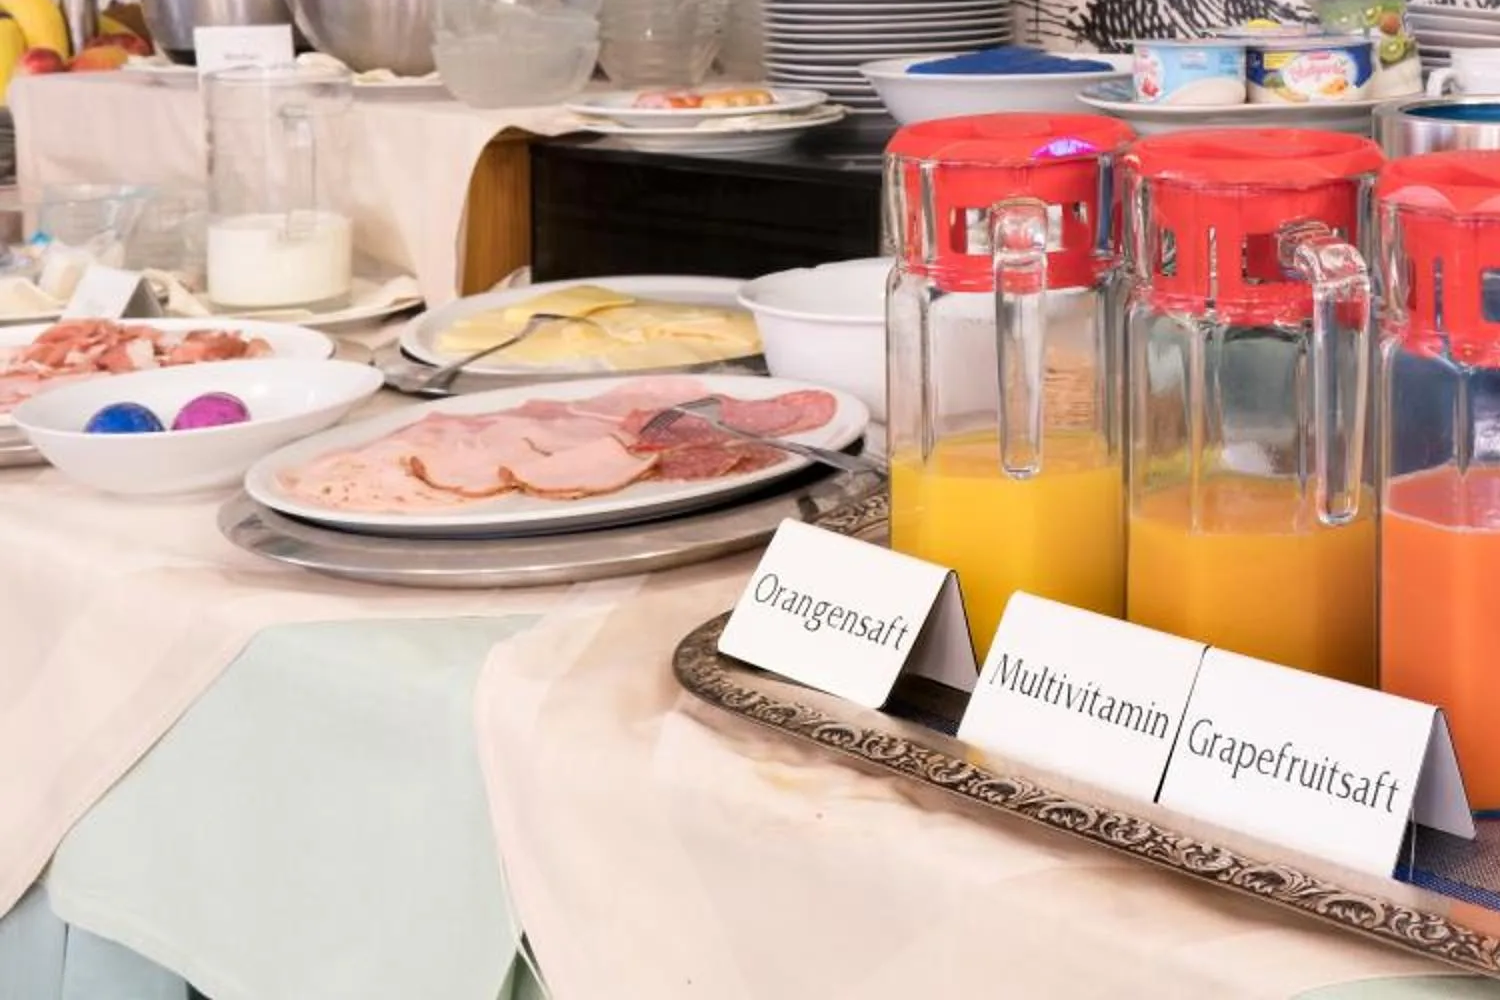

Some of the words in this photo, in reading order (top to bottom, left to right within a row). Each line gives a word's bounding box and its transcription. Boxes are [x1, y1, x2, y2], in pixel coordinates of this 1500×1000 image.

[755, 573, 909, 651] Orangensaft
[988, 653, 1171, 740] Multivitamin
[1187, 718, 1400, 813] Grapefruitsaft
